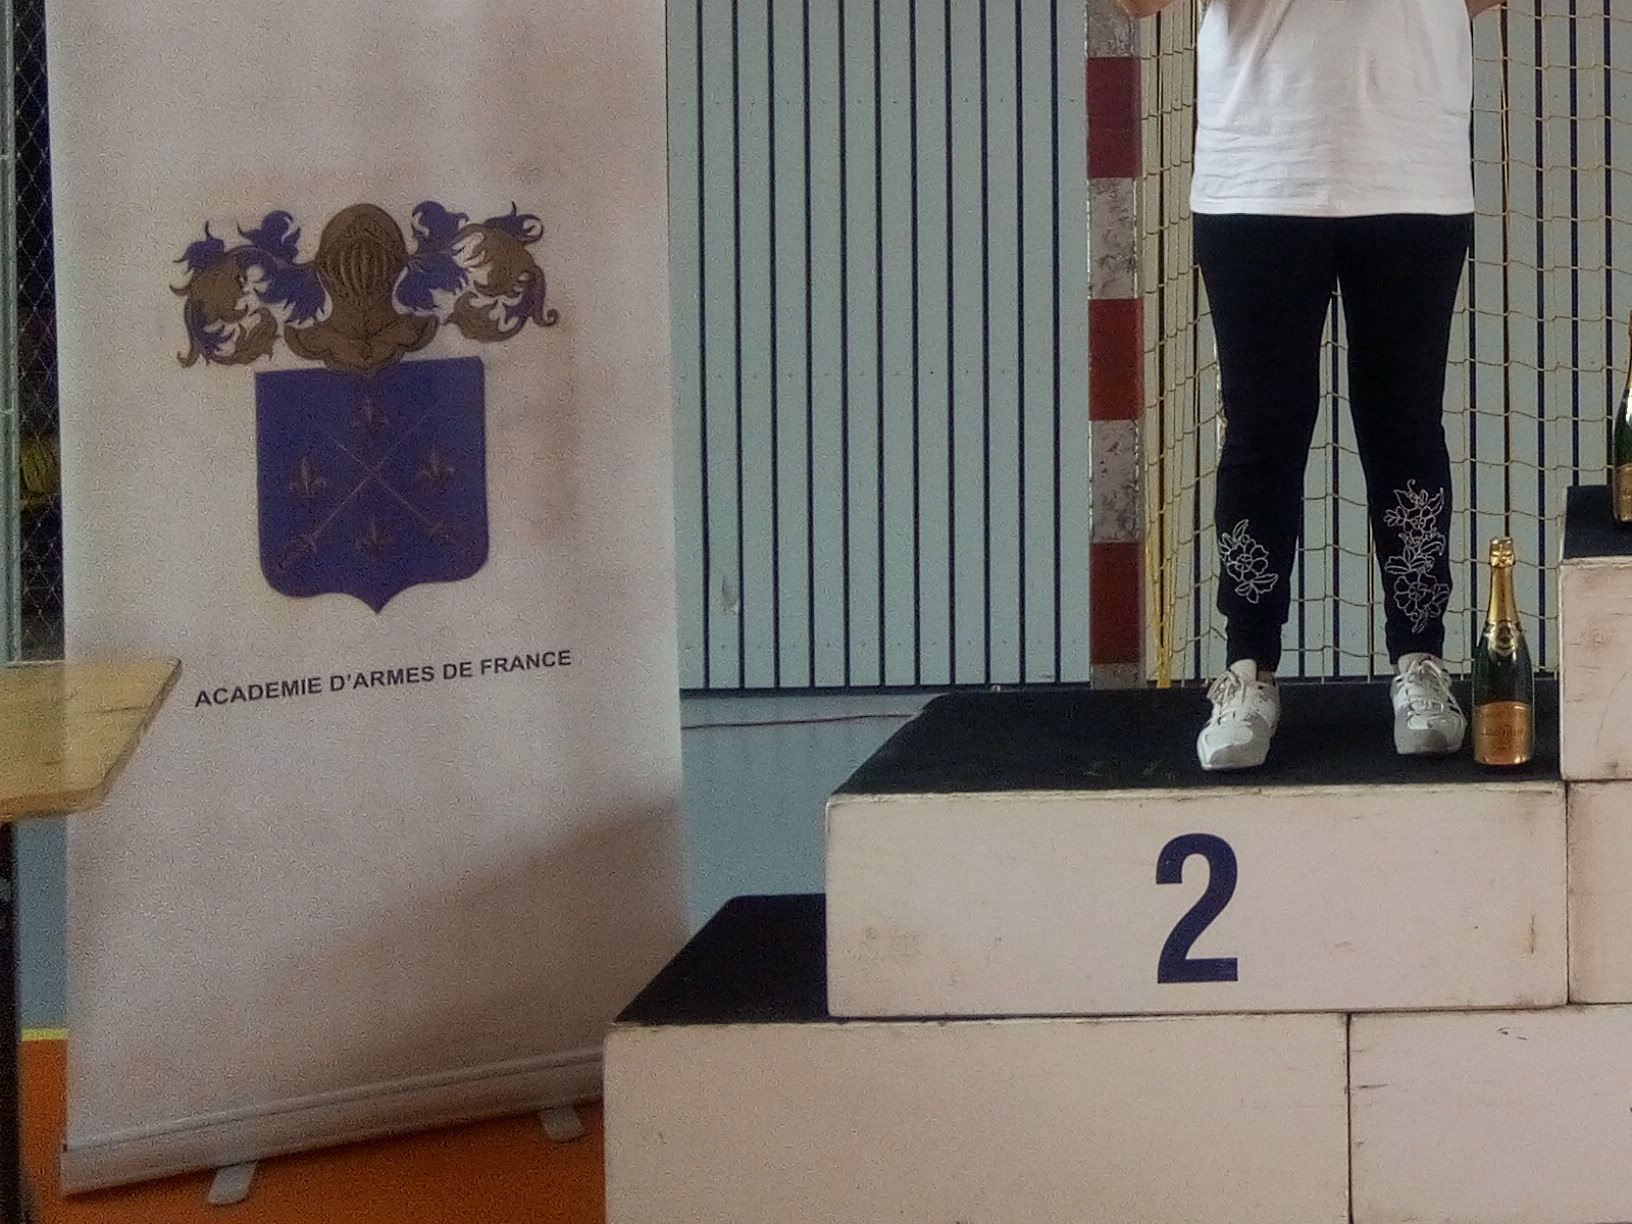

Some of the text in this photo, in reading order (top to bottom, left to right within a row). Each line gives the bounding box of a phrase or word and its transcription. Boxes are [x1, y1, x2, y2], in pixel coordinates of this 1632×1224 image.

[194, 650, 572, 708] ACADEMIE D'ARMES DE FRANCE
[1156, 833, 1238, 984] 2
